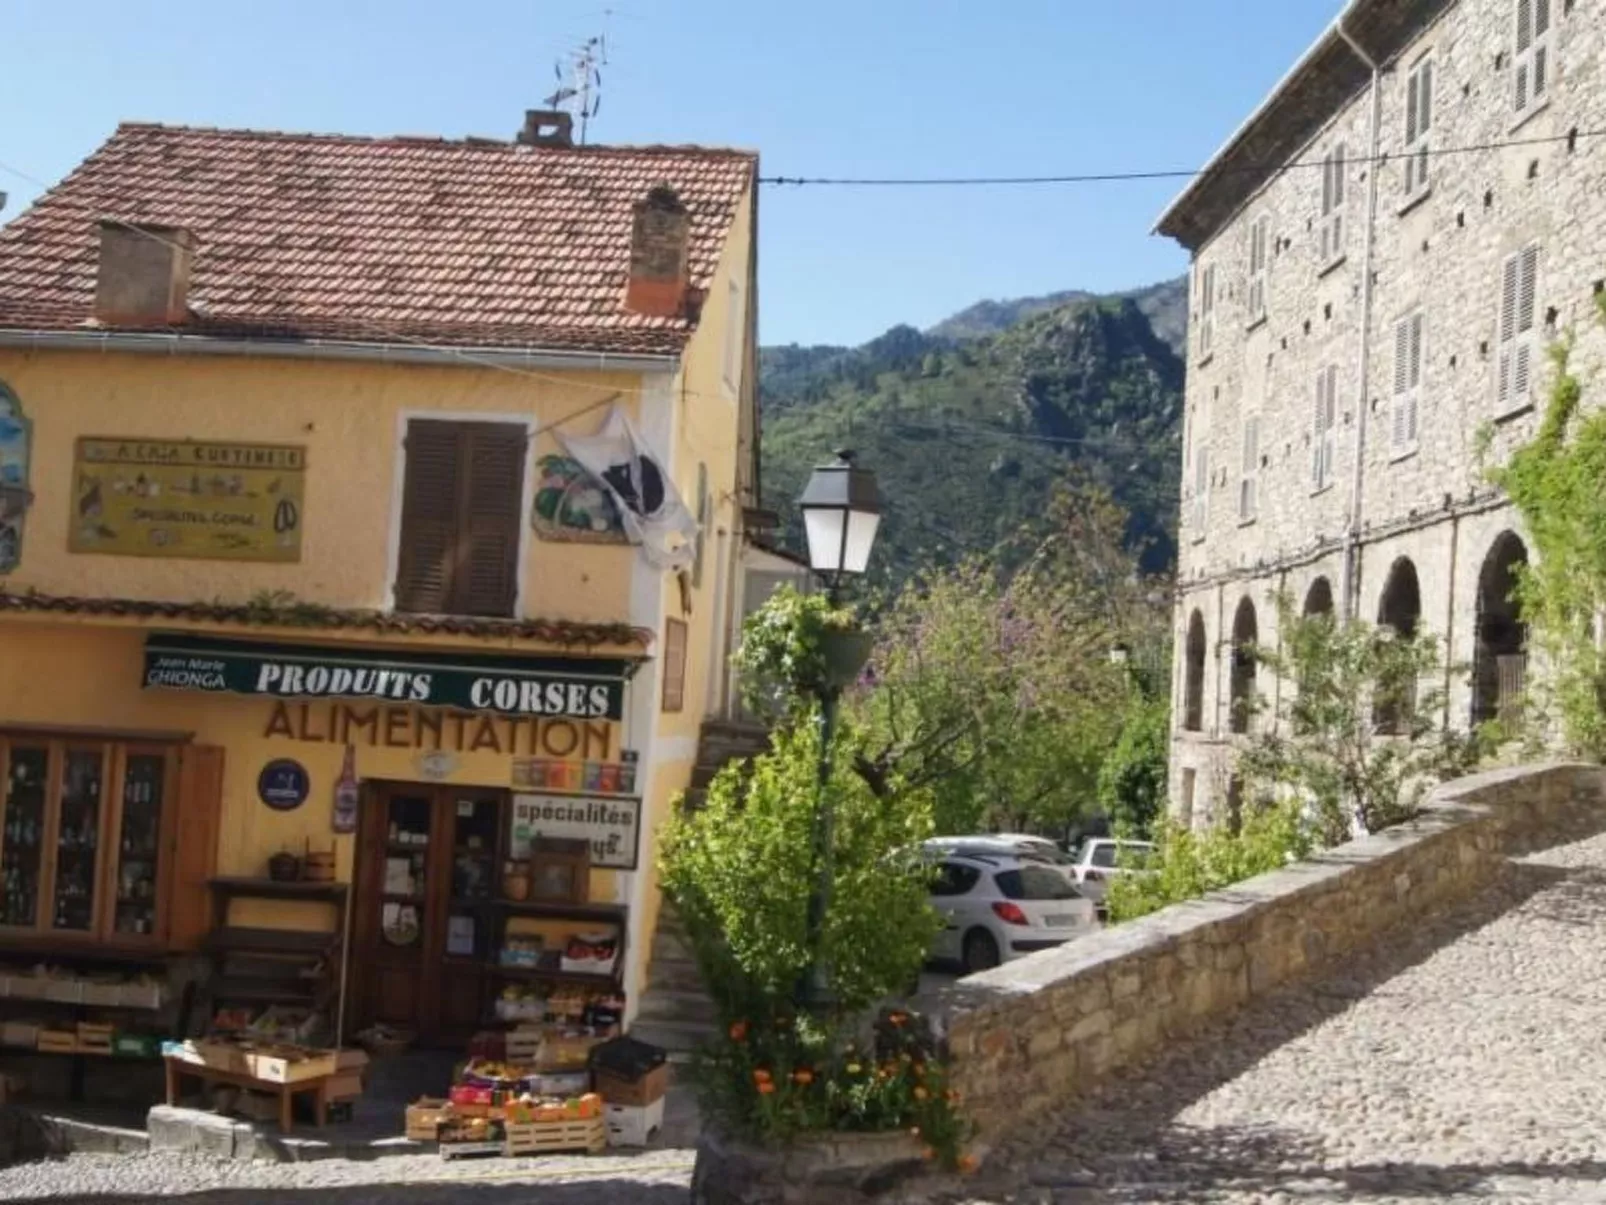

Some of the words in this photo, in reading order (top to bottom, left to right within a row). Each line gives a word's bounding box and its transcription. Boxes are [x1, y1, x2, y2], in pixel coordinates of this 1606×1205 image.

[188, 658, 226, 671] Marie
[148, 669, 226, 688] GHIONGA
[256, 663, 432, 700] PRODUITS
[470, 677, 609, 716] CORSES
[264, 700, 610, 759] ALIMENTATION
[516, 801, 633, 825] spécialités
